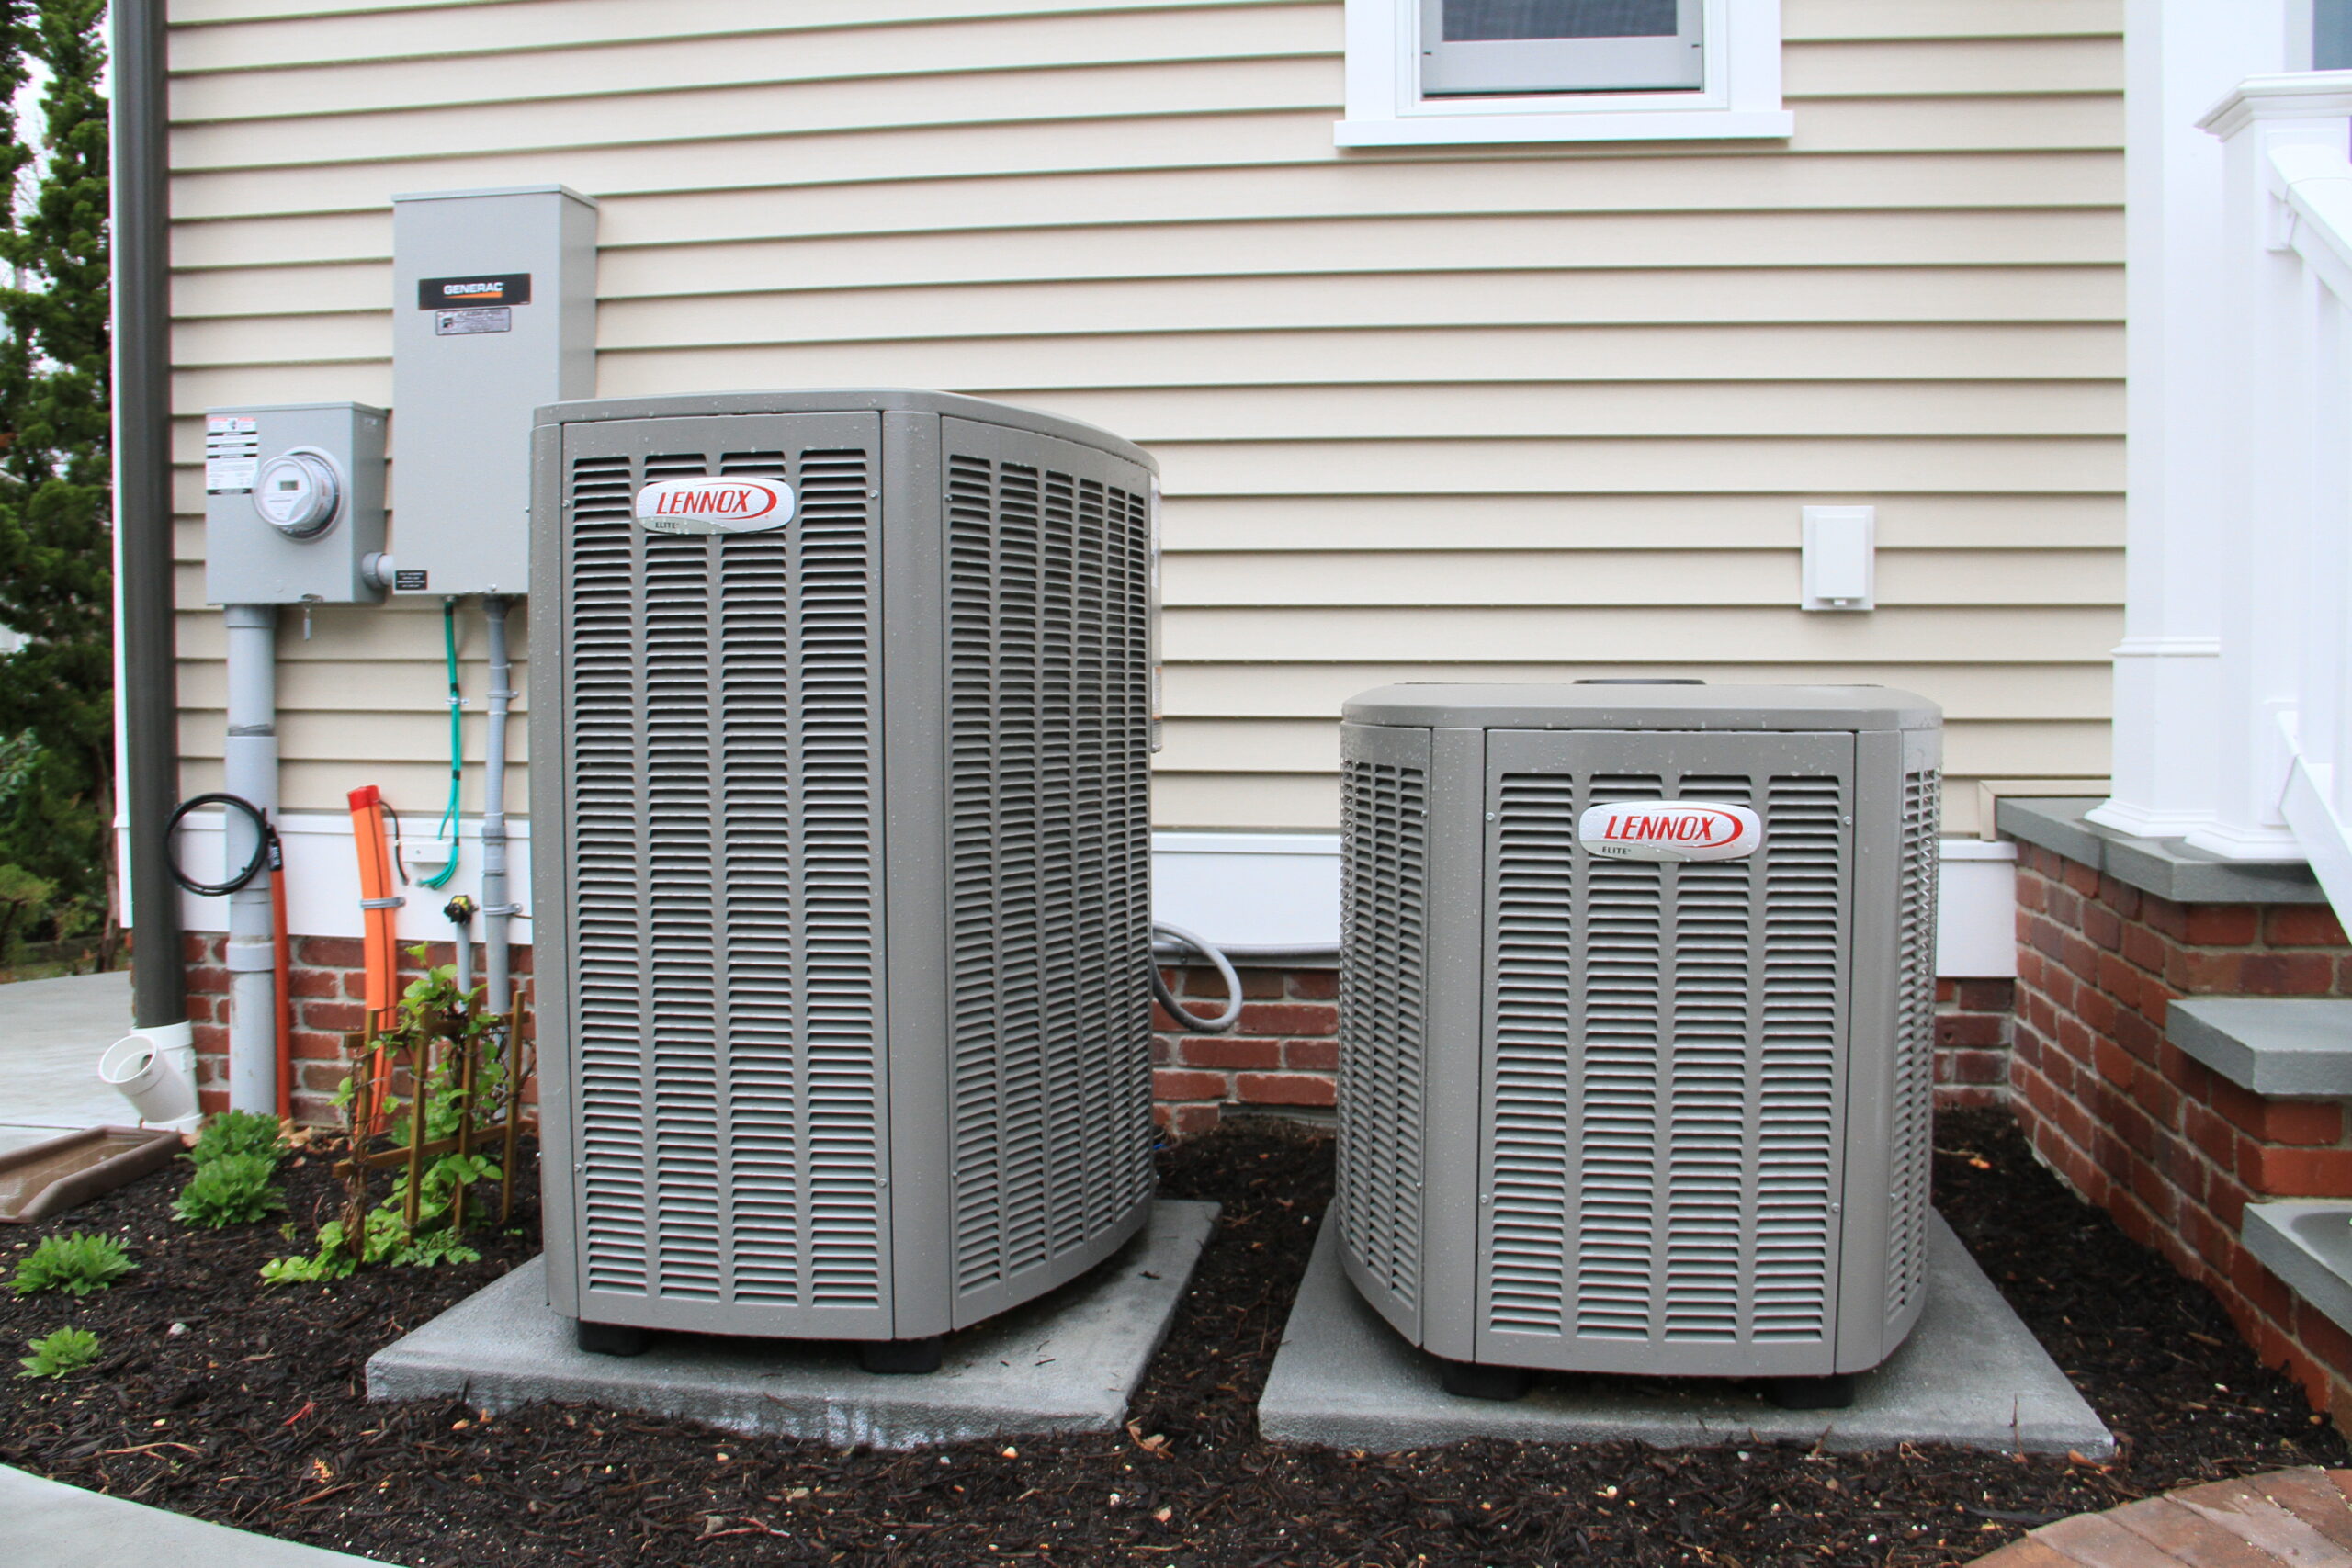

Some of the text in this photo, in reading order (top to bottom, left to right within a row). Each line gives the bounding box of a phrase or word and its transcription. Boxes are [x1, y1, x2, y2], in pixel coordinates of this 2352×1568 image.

[444, 282, 503, 295] GENERAC
[656, 490, 752, 514] LENNOX
[1604, 816, 1715, 840] LENNOX
[1602, 846, 1628, 855] ELITE
